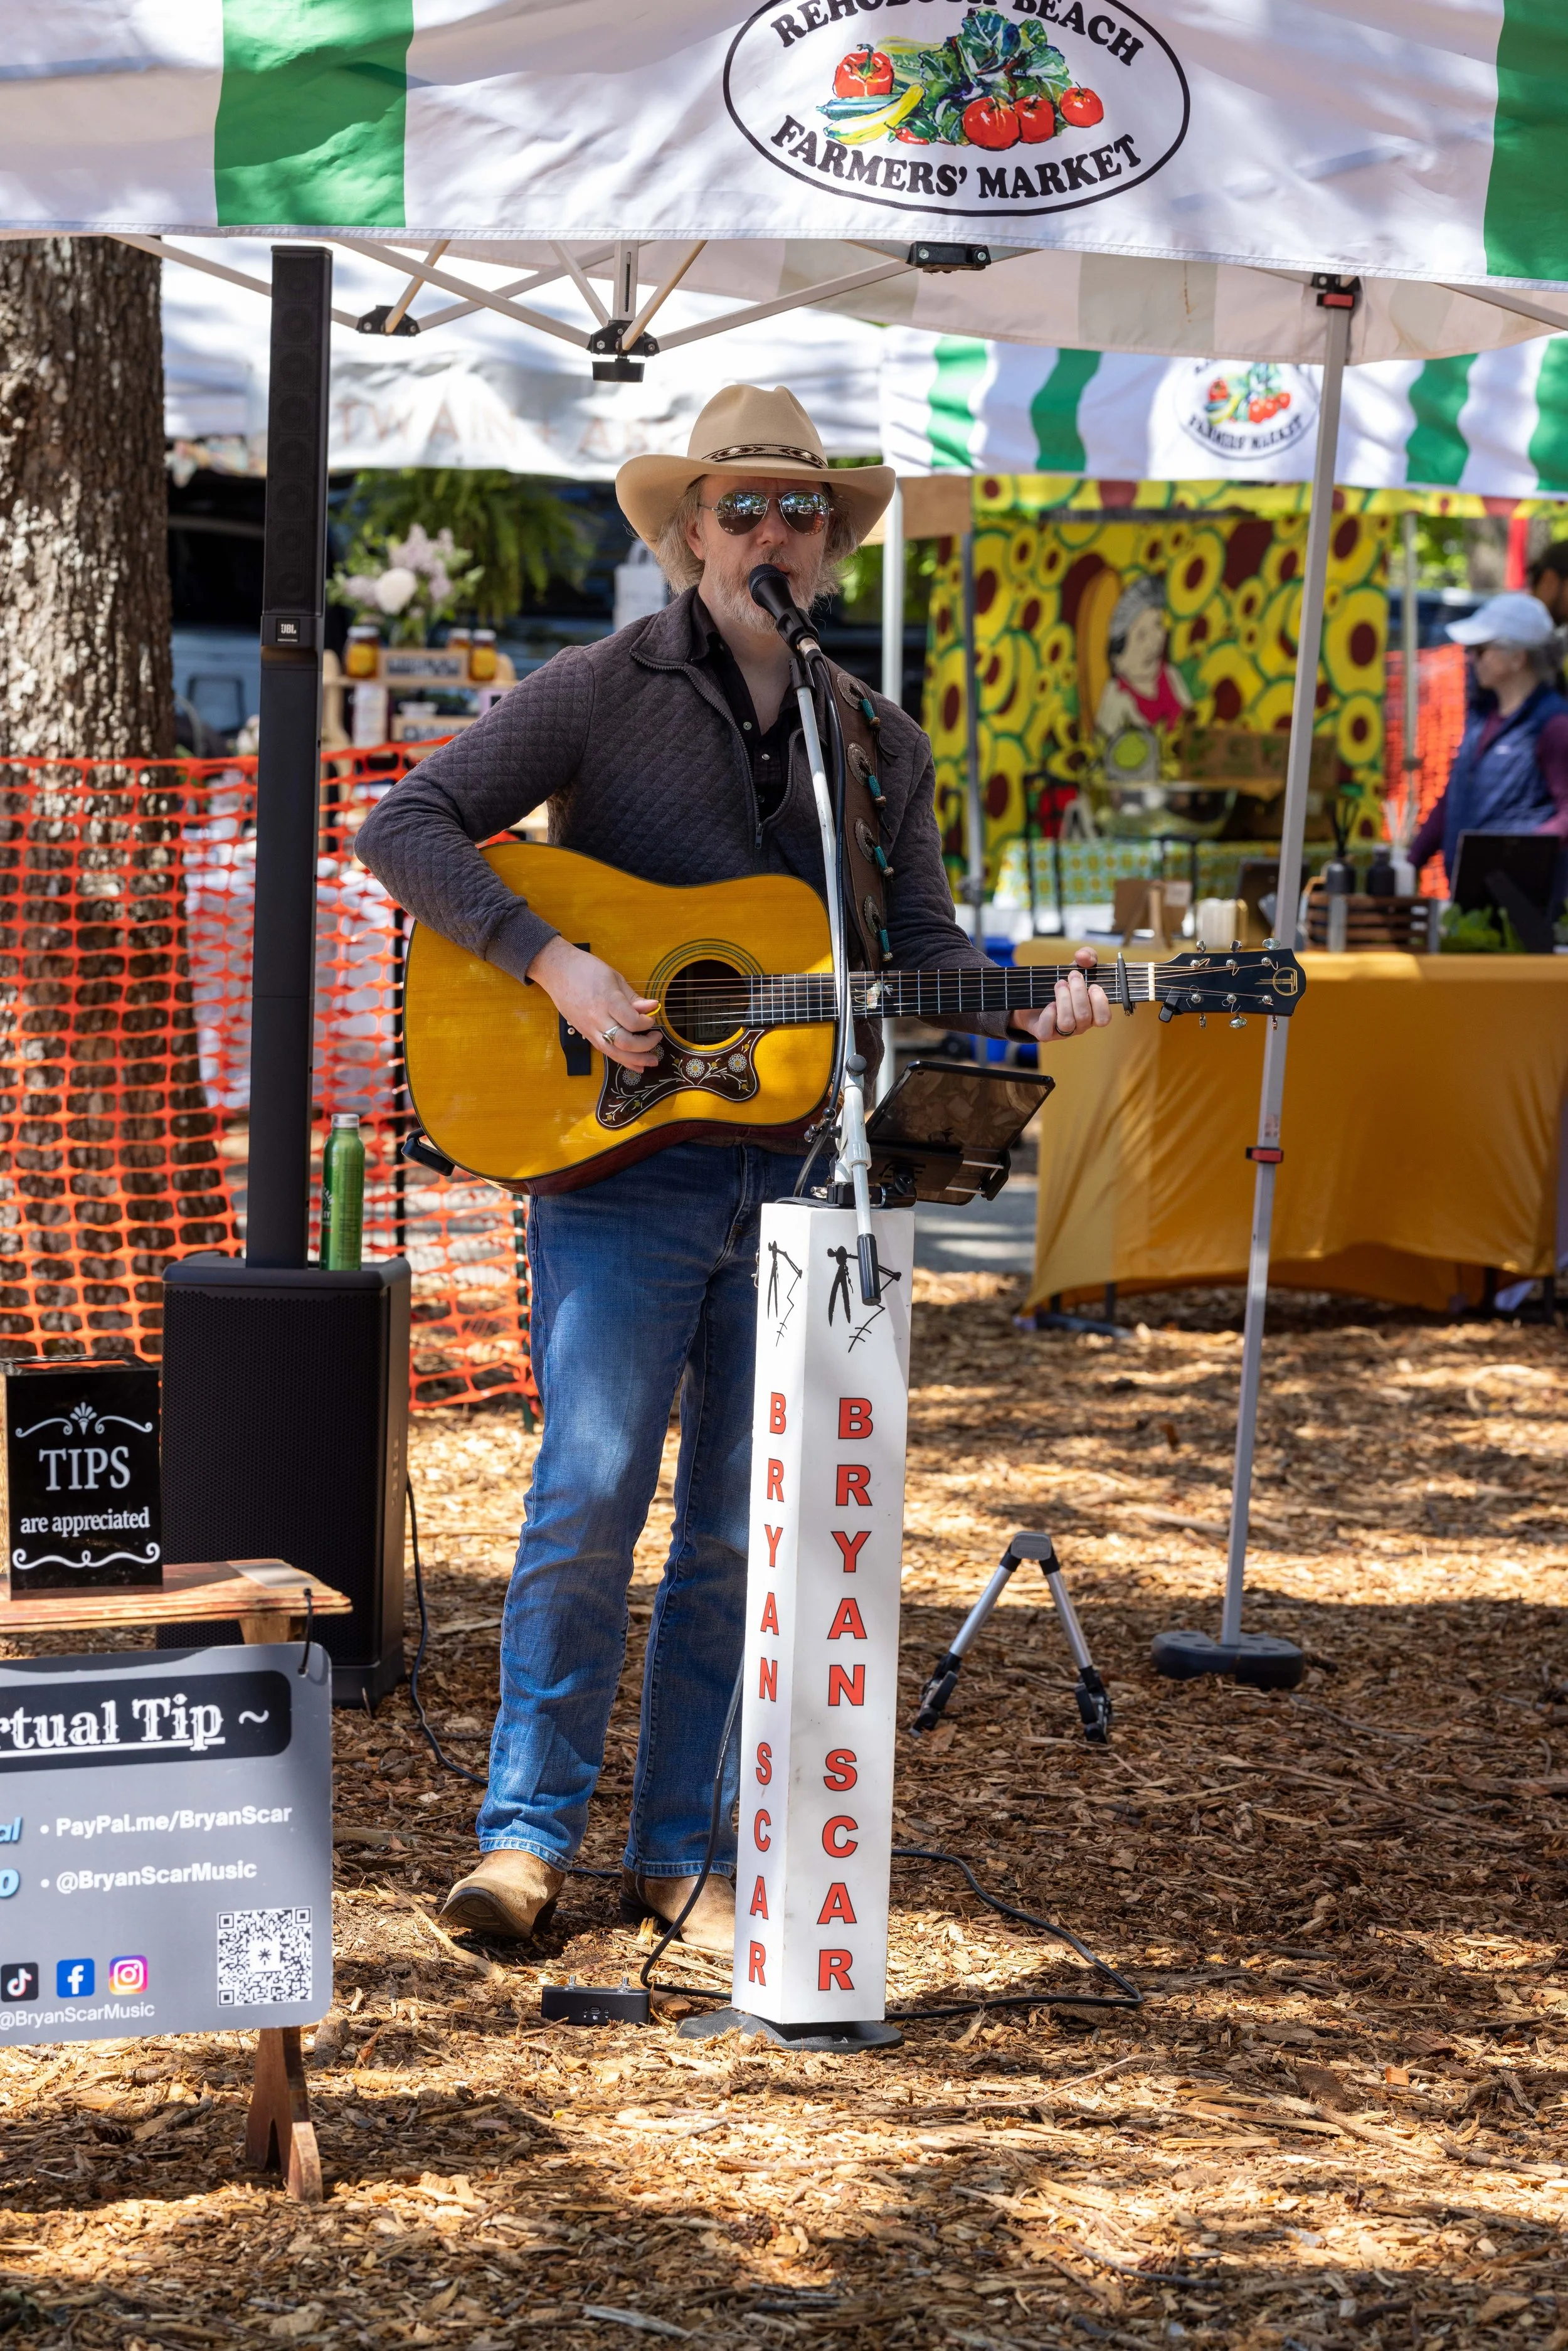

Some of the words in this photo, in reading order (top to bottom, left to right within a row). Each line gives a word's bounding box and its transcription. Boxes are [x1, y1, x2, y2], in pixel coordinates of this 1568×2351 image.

[770, 115, 968, 196] FARMERS'
[976, 134, 1142, 199] MARKET
[280, 624, 297, 634] JBL
[39, 1446, 130, 1490] TIPS
[21, 1517, 48, 1534] are
[52, 1506, 150, 1537] appreciated
[759, 1392, 787, 1702] BRYAN
[827, 1398, 874, 1706] BRYAN
[132, 1693, 224, 1751] Tip
[56, 1805, 293, 1839] PayPal.me/BryanScar
[56, 1860, 258, 1894] @BryanScarMusic
[749, 1742, 772, 1987] SCAR
[816, 1749, 859, 1991] SCAR
[0, 2002, 156, 2030] @BryanScarMusic
